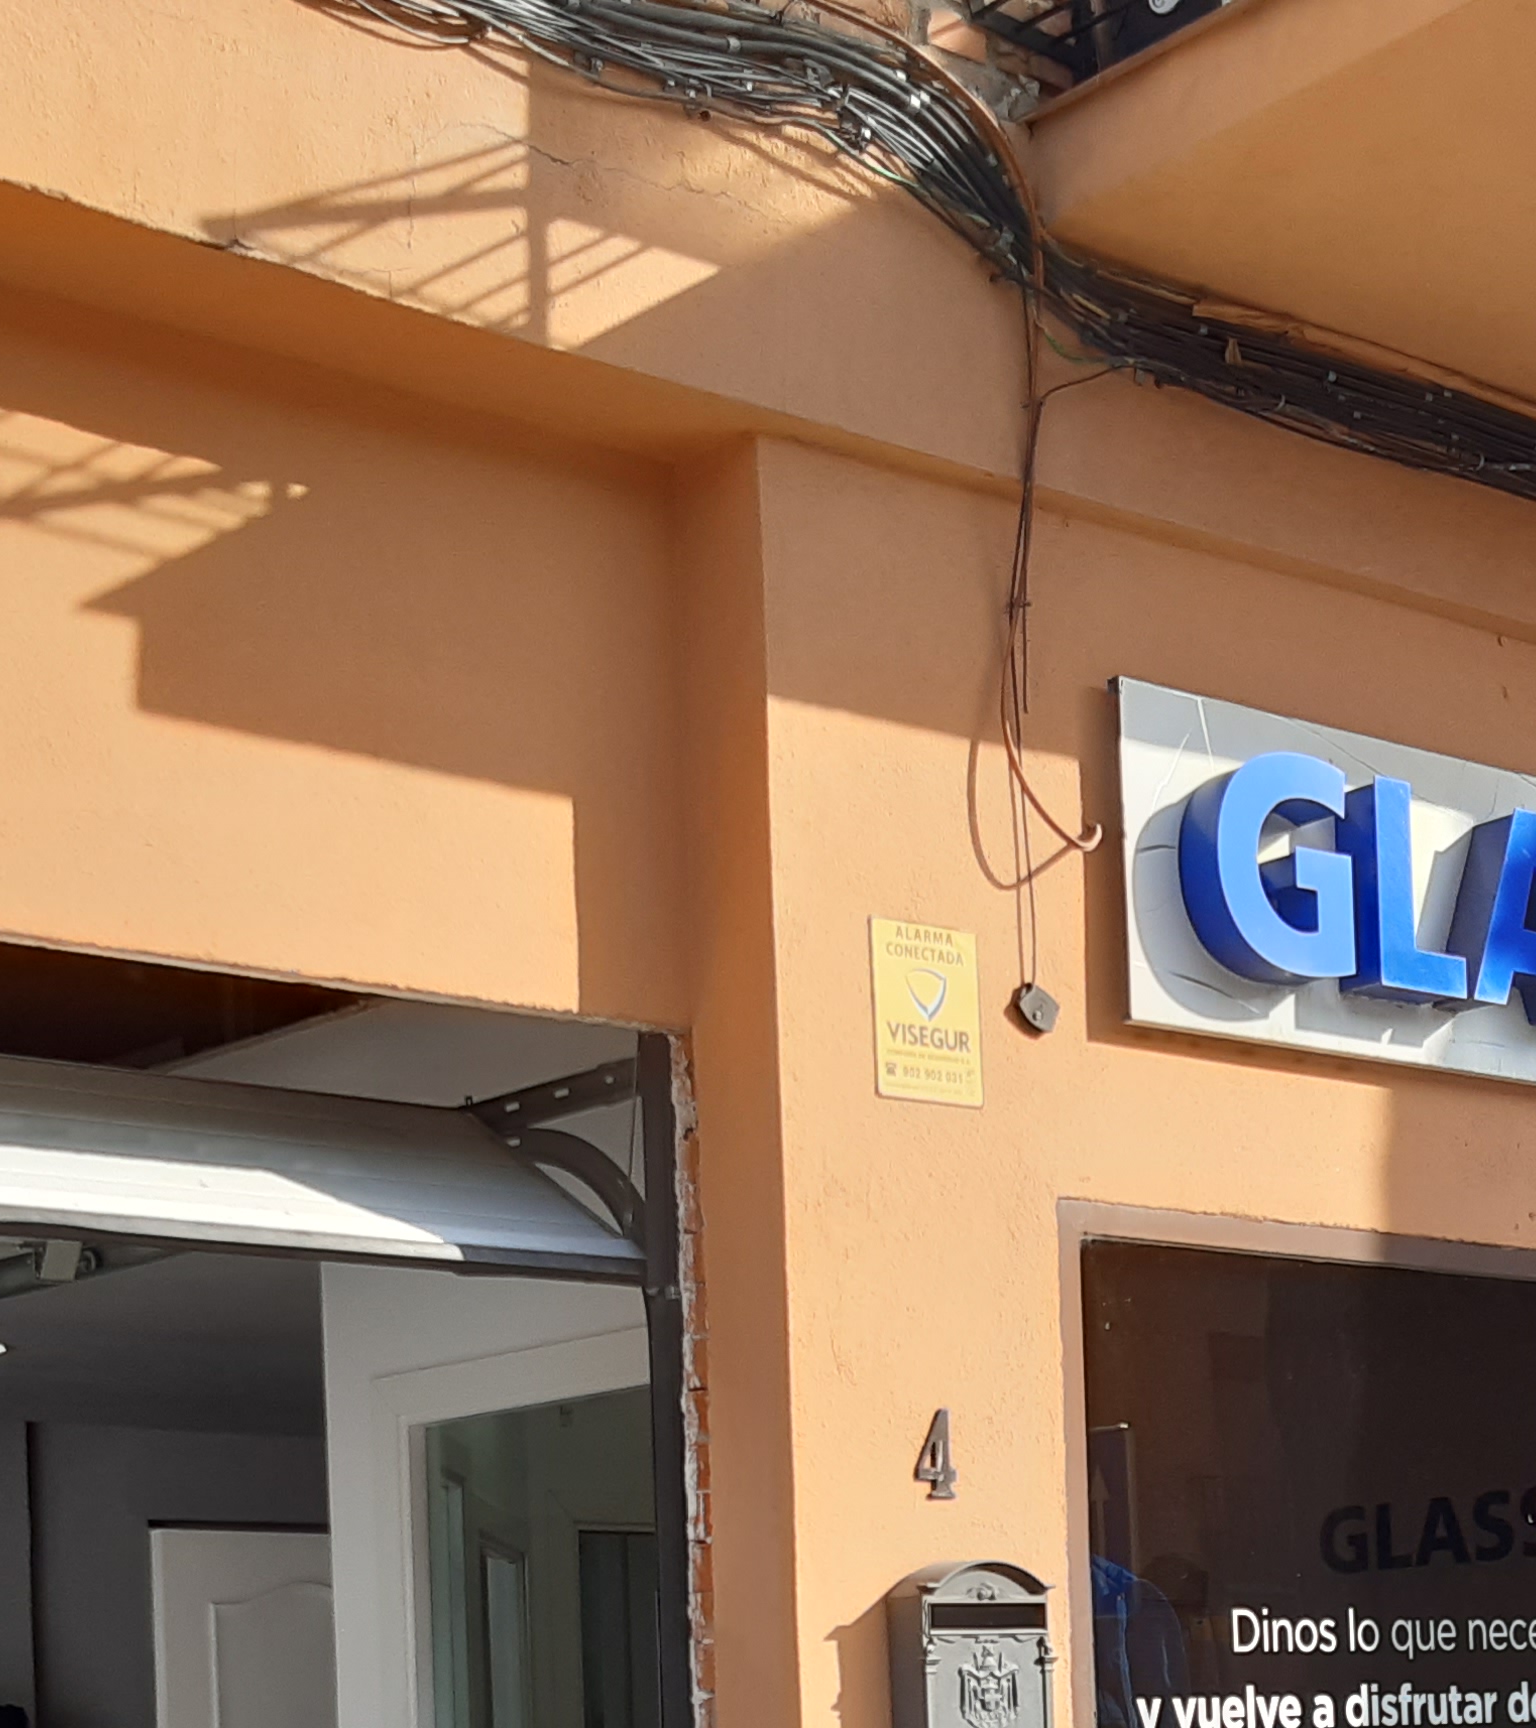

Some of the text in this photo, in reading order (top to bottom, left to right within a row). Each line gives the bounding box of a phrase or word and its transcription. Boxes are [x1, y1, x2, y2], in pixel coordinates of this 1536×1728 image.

[885, 942, 964, 967] CONECTADA
[895, 925, 954, 947] ALARMA
[886, 1020, 971, 1053] VISEGUR
[914, 1407, 957, 1500] 4
[1230, 1607, 1338, 1655] Dinos
[1347, 1607, 1381, 1653] lo
[1390, 1617, 1459, 1660] que
[1312, 1696, 1336, 1728] a
[1344, 1682, 1498, 1727] disfrutar
